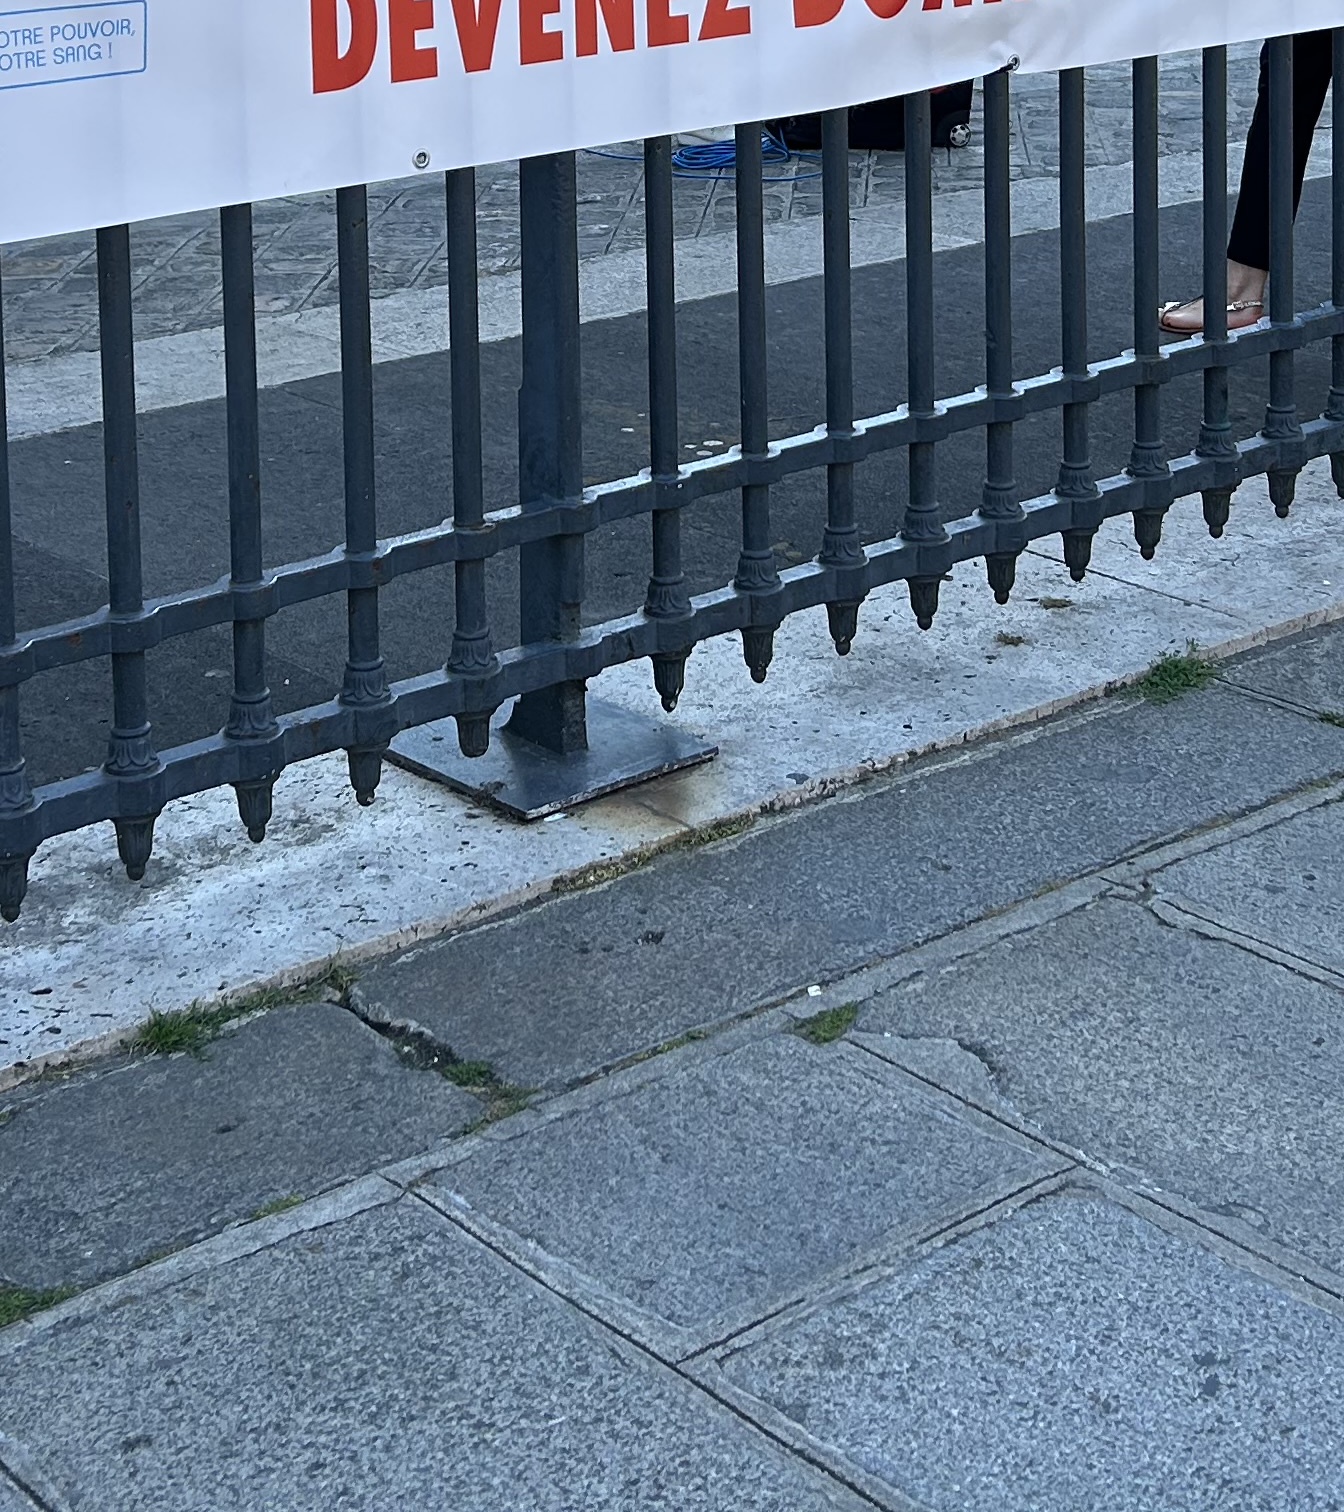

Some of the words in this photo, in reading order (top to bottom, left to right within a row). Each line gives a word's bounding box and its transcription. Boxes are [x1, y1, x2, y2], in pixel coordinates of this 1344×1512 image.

[50, 18, 136, 43] POUVOIR,
[53, 44, 103, 65] SANG
[107, 42, 113, 59] !
